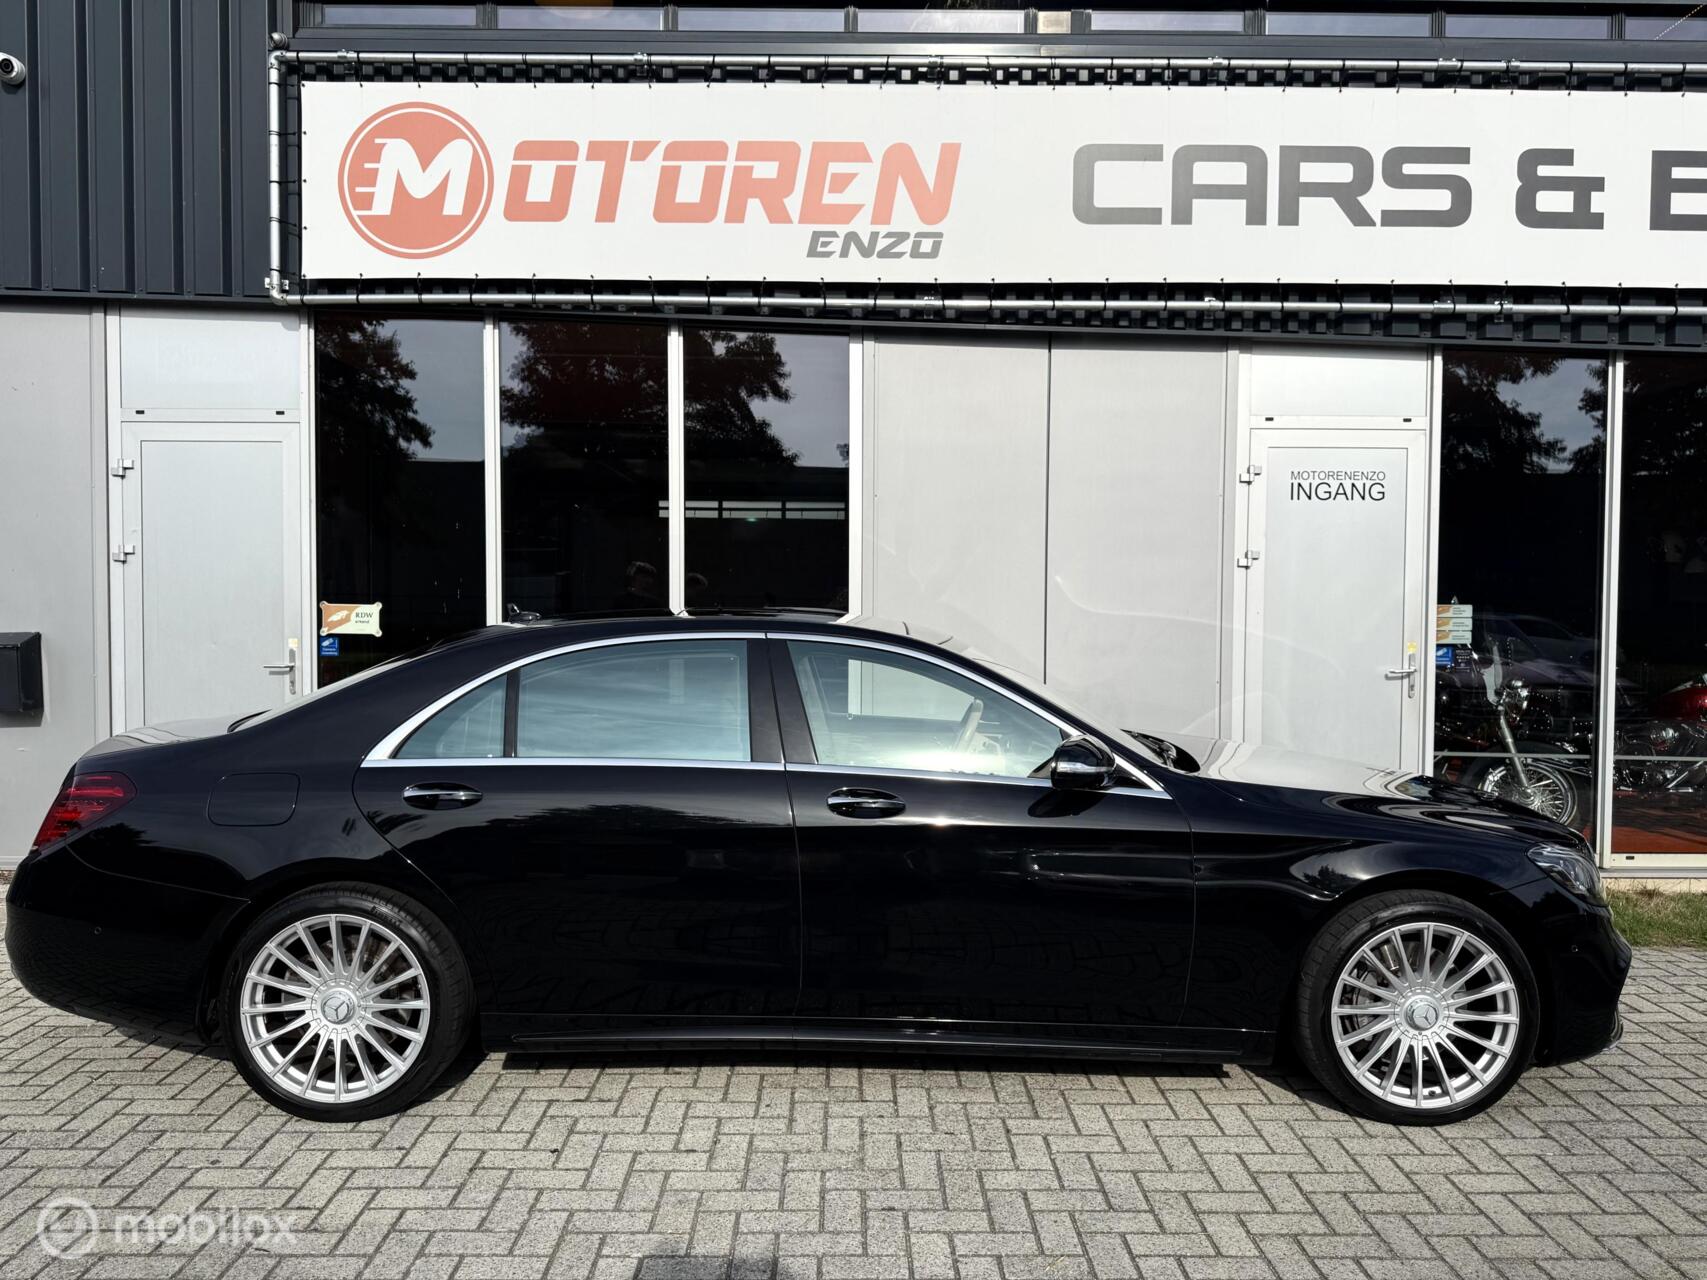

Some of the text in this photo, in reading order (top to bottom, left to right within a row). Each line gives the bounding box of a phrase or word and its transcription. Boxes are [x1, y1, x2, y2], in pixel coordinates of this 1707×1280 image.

[1074, 144, 1473, 228] CARS
[1516, 148, 1606, 230] &
[805, 230, 944, 260] ENZO
[1290, 470, 1386, 483] MOTORENENZO
[1290, 482, 1386, 502] INGANG
[355, 611, 374, 619] RDW
